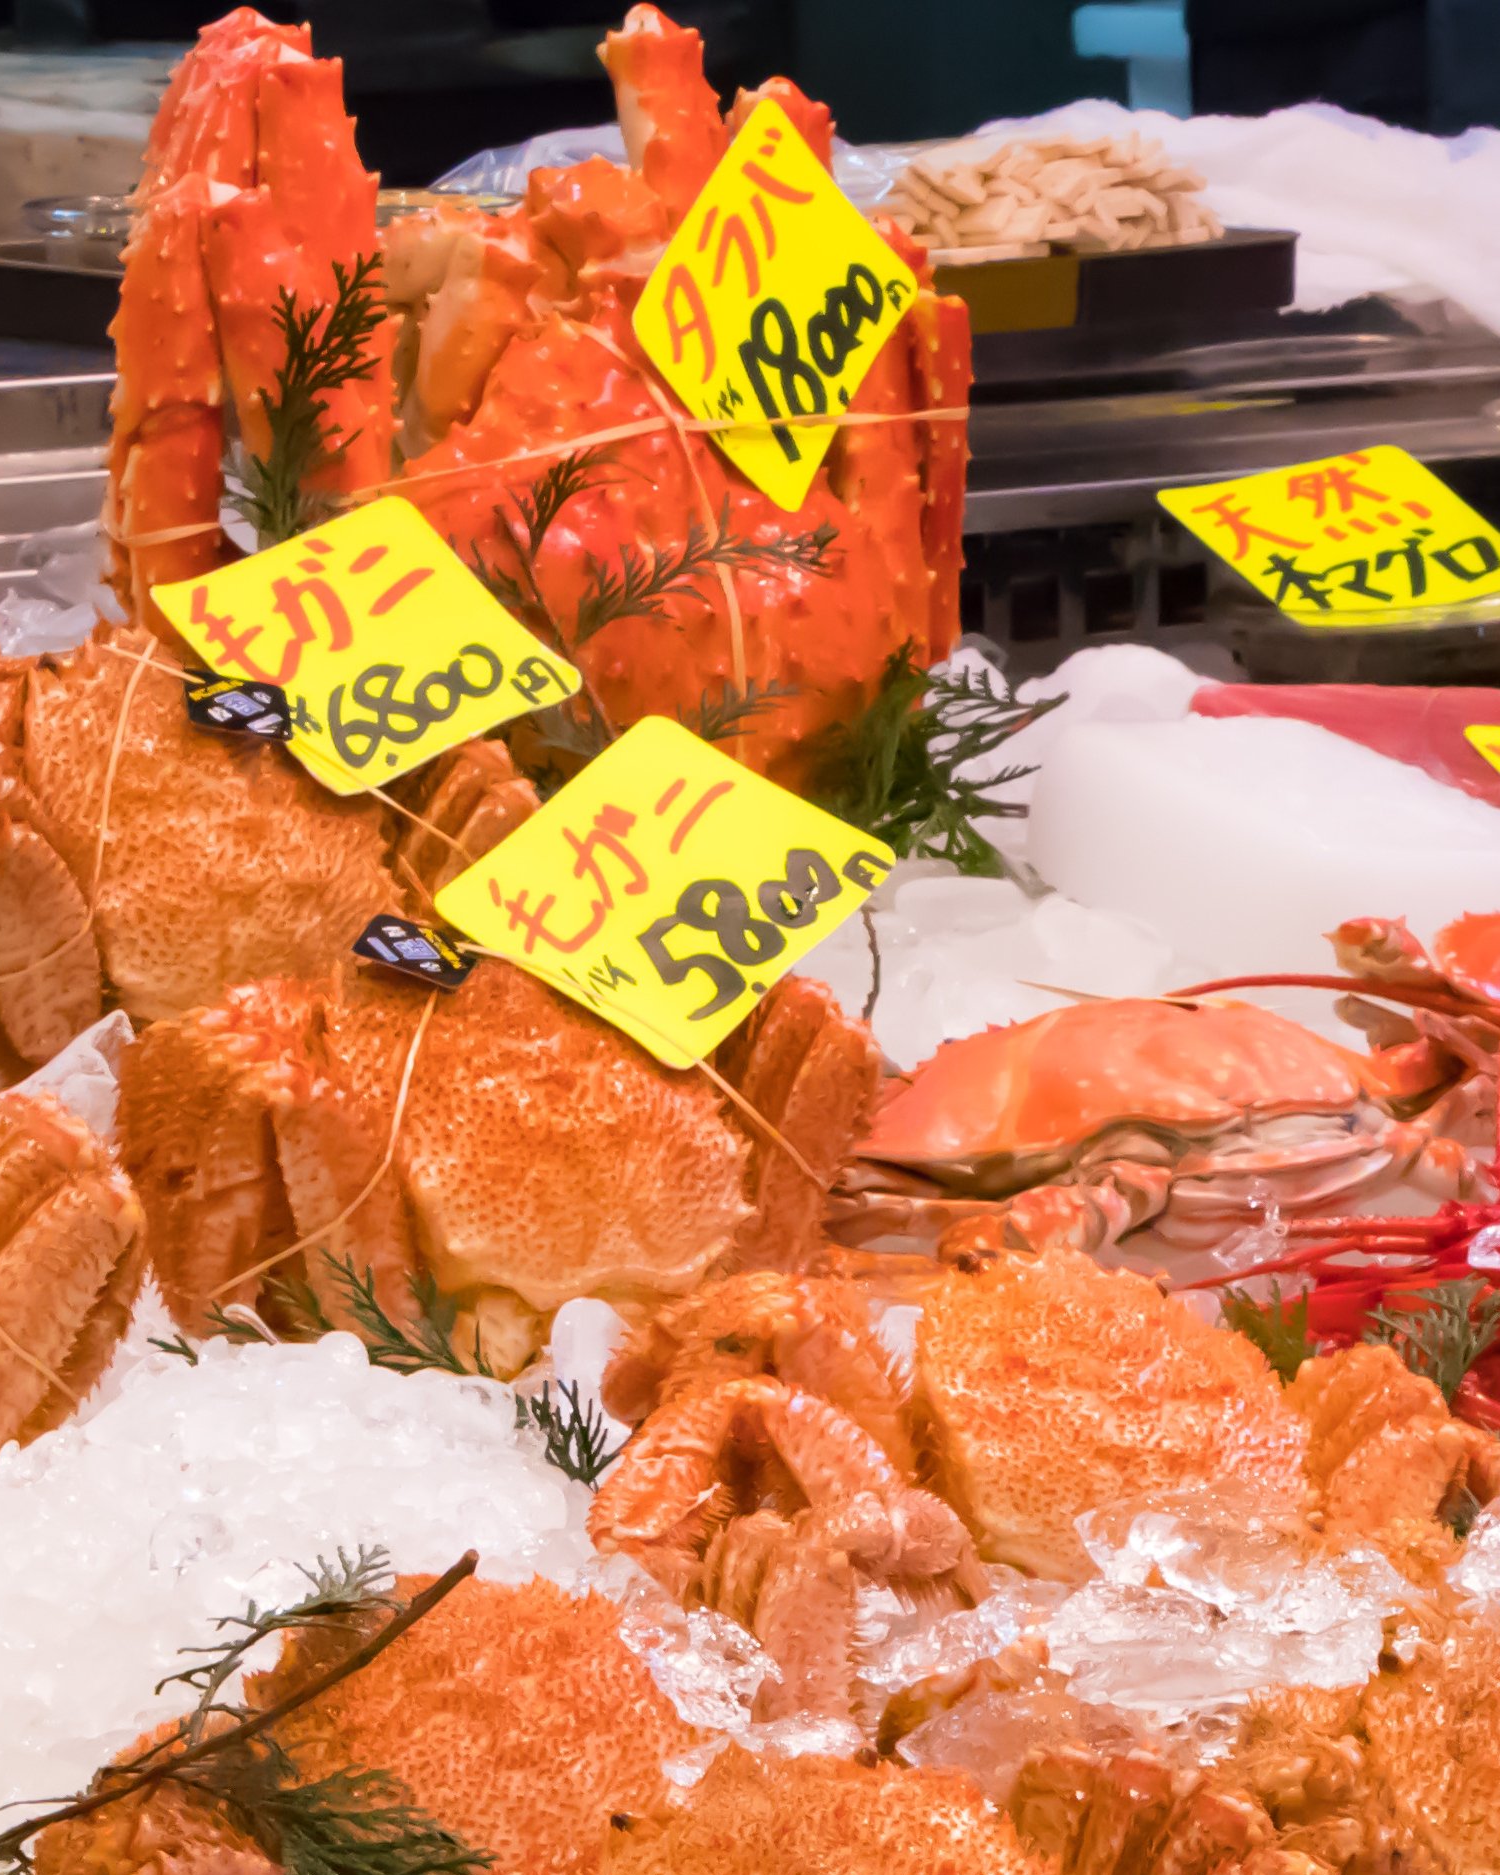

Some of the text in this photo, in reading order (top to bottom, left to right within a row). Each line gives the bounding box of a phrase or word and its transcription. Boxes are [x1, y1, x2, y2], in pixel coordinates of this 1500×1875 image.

[662, 127, 815, 385] タラバ
[1190, 453, 1432, 562] 天然
[190, 538, 435, 686] 毛ガニ
[488, 778, 735, 954] 毛ガニ
